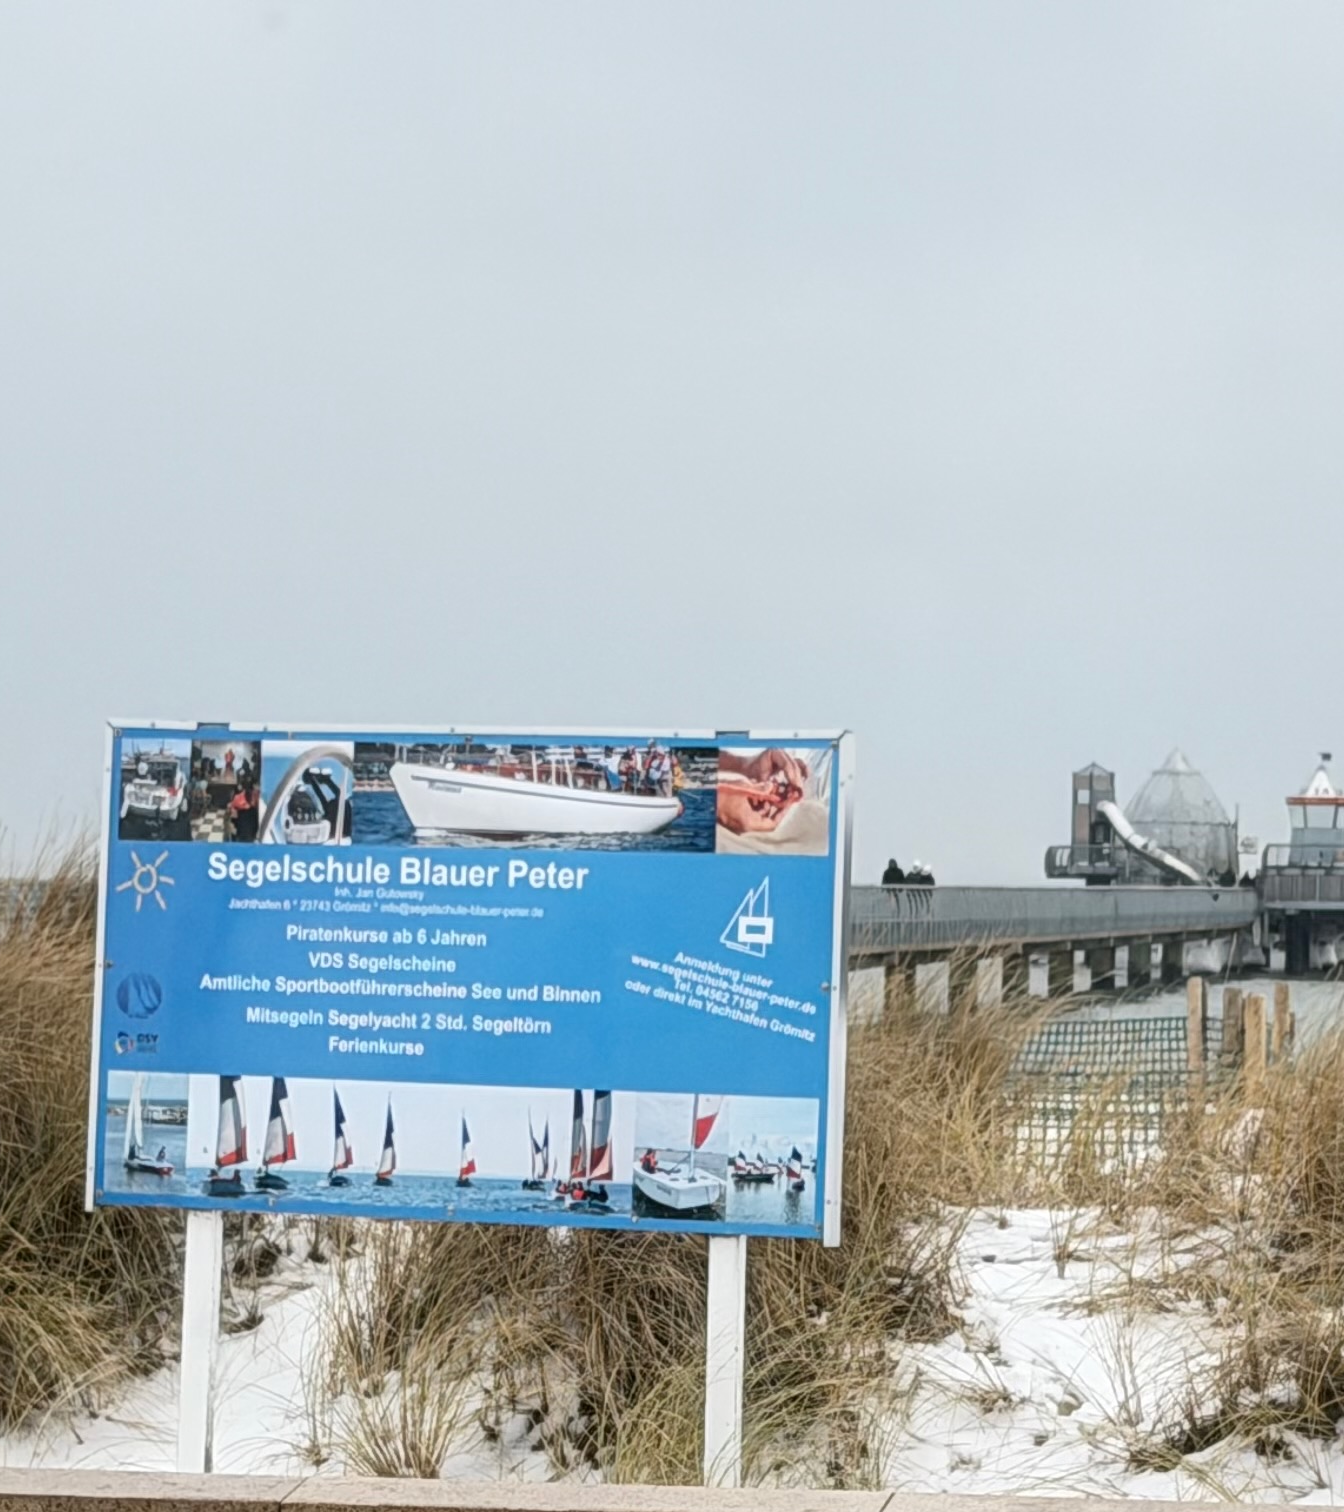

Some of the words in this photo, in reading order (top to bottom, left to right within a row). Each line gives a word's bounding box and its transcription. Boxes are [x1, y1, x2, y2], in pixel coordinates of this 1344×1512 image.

[207, 851, 390, 888] Segelschule
[400, 856, 500, 887] Blauer
[507, 859, 589, 889] Peter
[300, 900, 331, 912] 23743
[356, 887, 374, 898] Jan
[286, 924, 388, 944] Piratenkurse
[392, 928, 413, 945] ab
[417, 928, 427, 945] 6
[430, 929, 488, 947] Jahren
[308, 951, 343, 969] VDS
[348, 953, 456, 974] Segelscheine
[673, 951, 740, 982] Anmeldung
[742, 972, 773, 988] unter
[199, 973, 271, 993] Amtliche
[274, 975, 467, 998] Sportbootführerscheine
[471, 982, 502, 999] See
[506, 984, 538, 1001] und
[542, 984, 601, 1003] Binnen
[631, 954, 816, 1015] www.segelschule-blauer-peter.de
[674, 979, 694, 993] Tel.
[696, 984, 730, 1004] 04562
[246, 1007, 323, 1028] Mitsegeln
[327, 1009, 417, 1031] Segelyacht
[421, 1013, 431, 1029] 2
[435, 1014, 468, 1031] Std.
[472, 1015, 552, 1036] Segeltörn
[624, 980, 651, 995] oder
[653, 987, 686, 1006] direkt
[687, 994, 703, 1010] im
[705, 999, 768, 1029] Yachthafen
[770, 1018, 816, 1042] Grömitz
[328, 1036, 424, 1056] Ferienkurse
